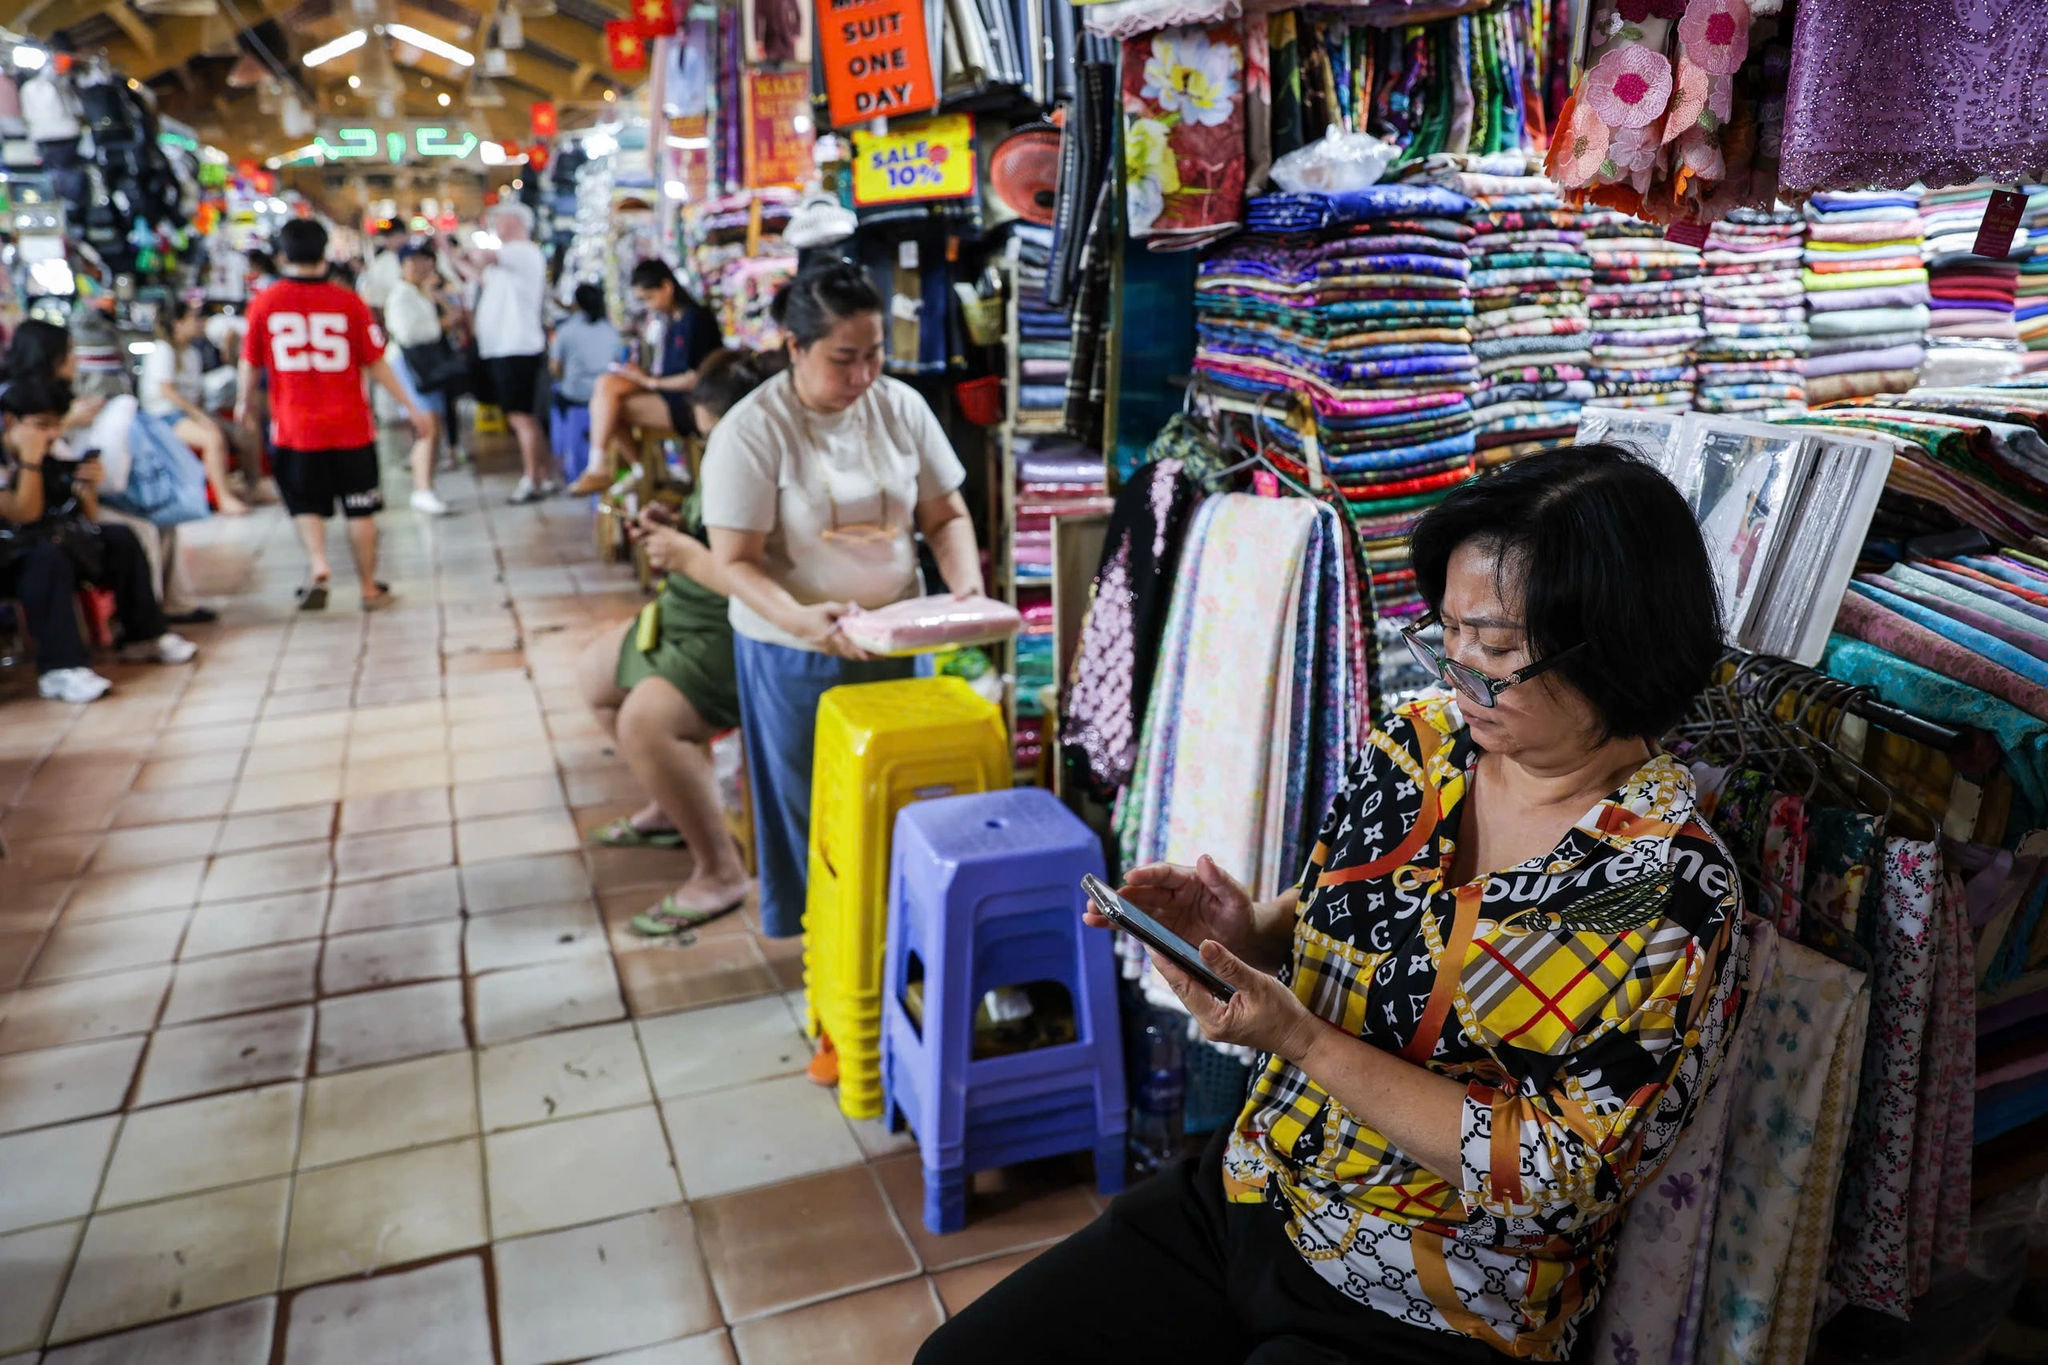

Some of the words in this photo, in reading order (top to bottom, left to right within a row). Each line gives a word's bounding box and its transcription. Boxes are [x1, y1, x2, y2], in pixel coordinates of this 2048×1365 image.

[842, 13, 903, 44] SUIT
[849, 48, 908, 78] ONE
[856, 82, 913, 115] DAY
[873, 140, 928, 169] SALE
[888, 163, 942, 188] 10%
[267, 312, 350, 372] 25
